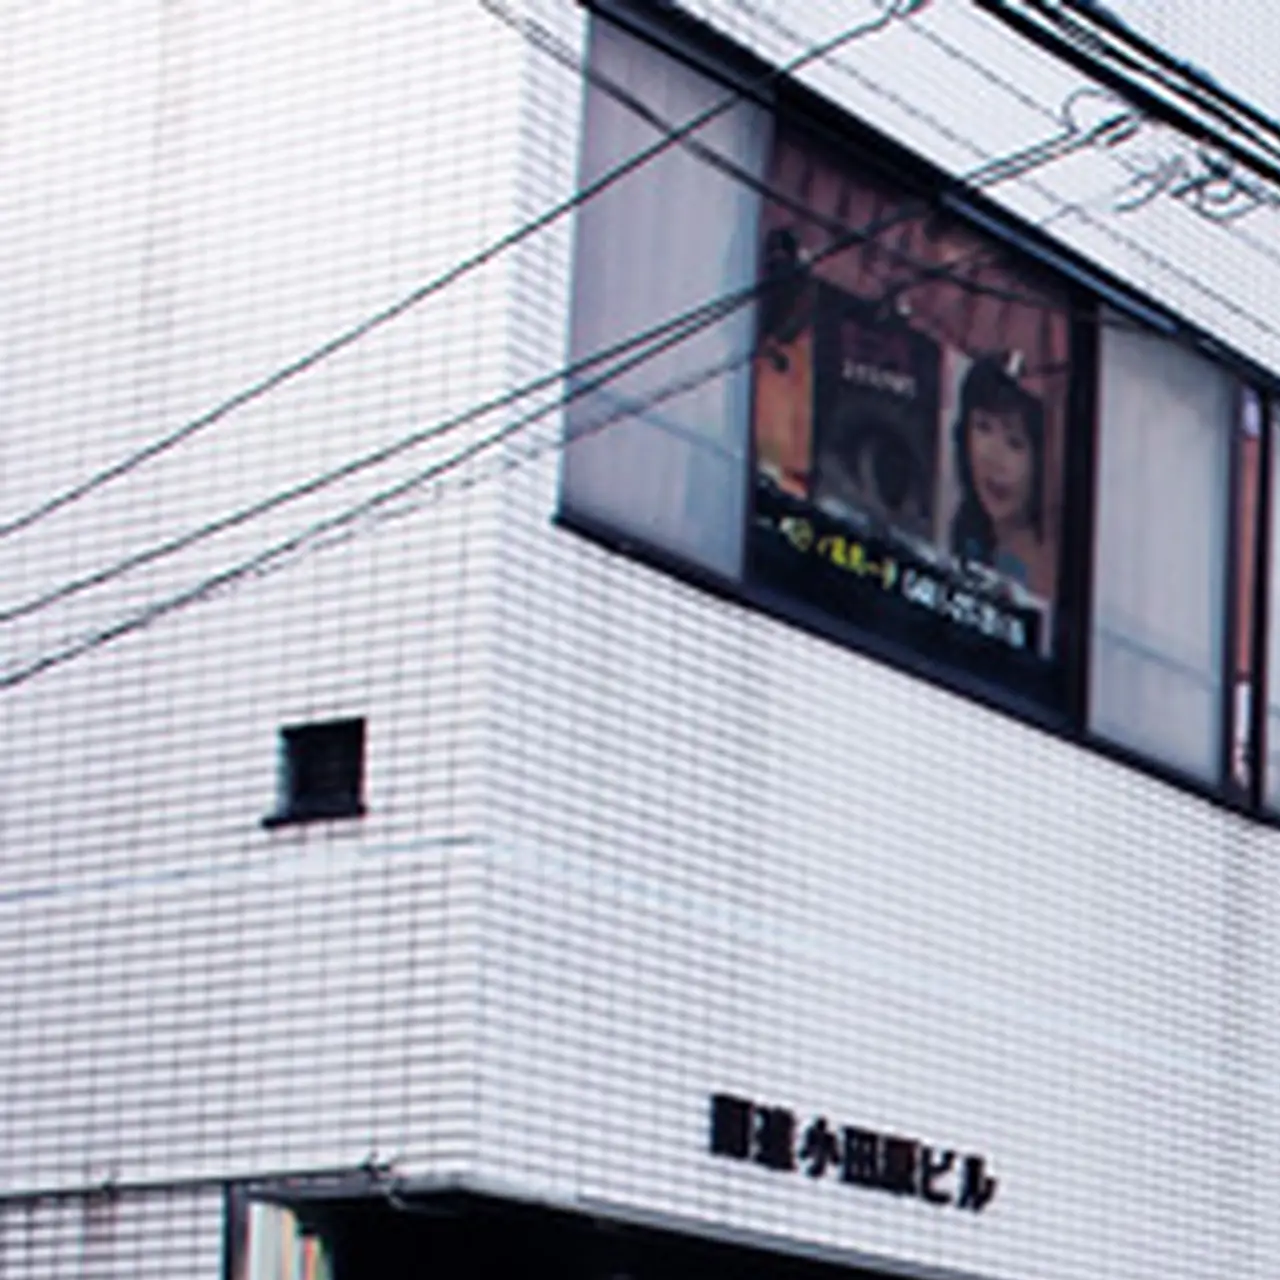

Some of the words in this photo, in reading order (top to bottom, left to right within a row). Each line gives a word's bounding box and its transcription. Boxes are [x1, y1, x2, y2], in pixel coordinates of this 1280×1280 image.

[708, 1092, 997, 1212] 小田原ビル
